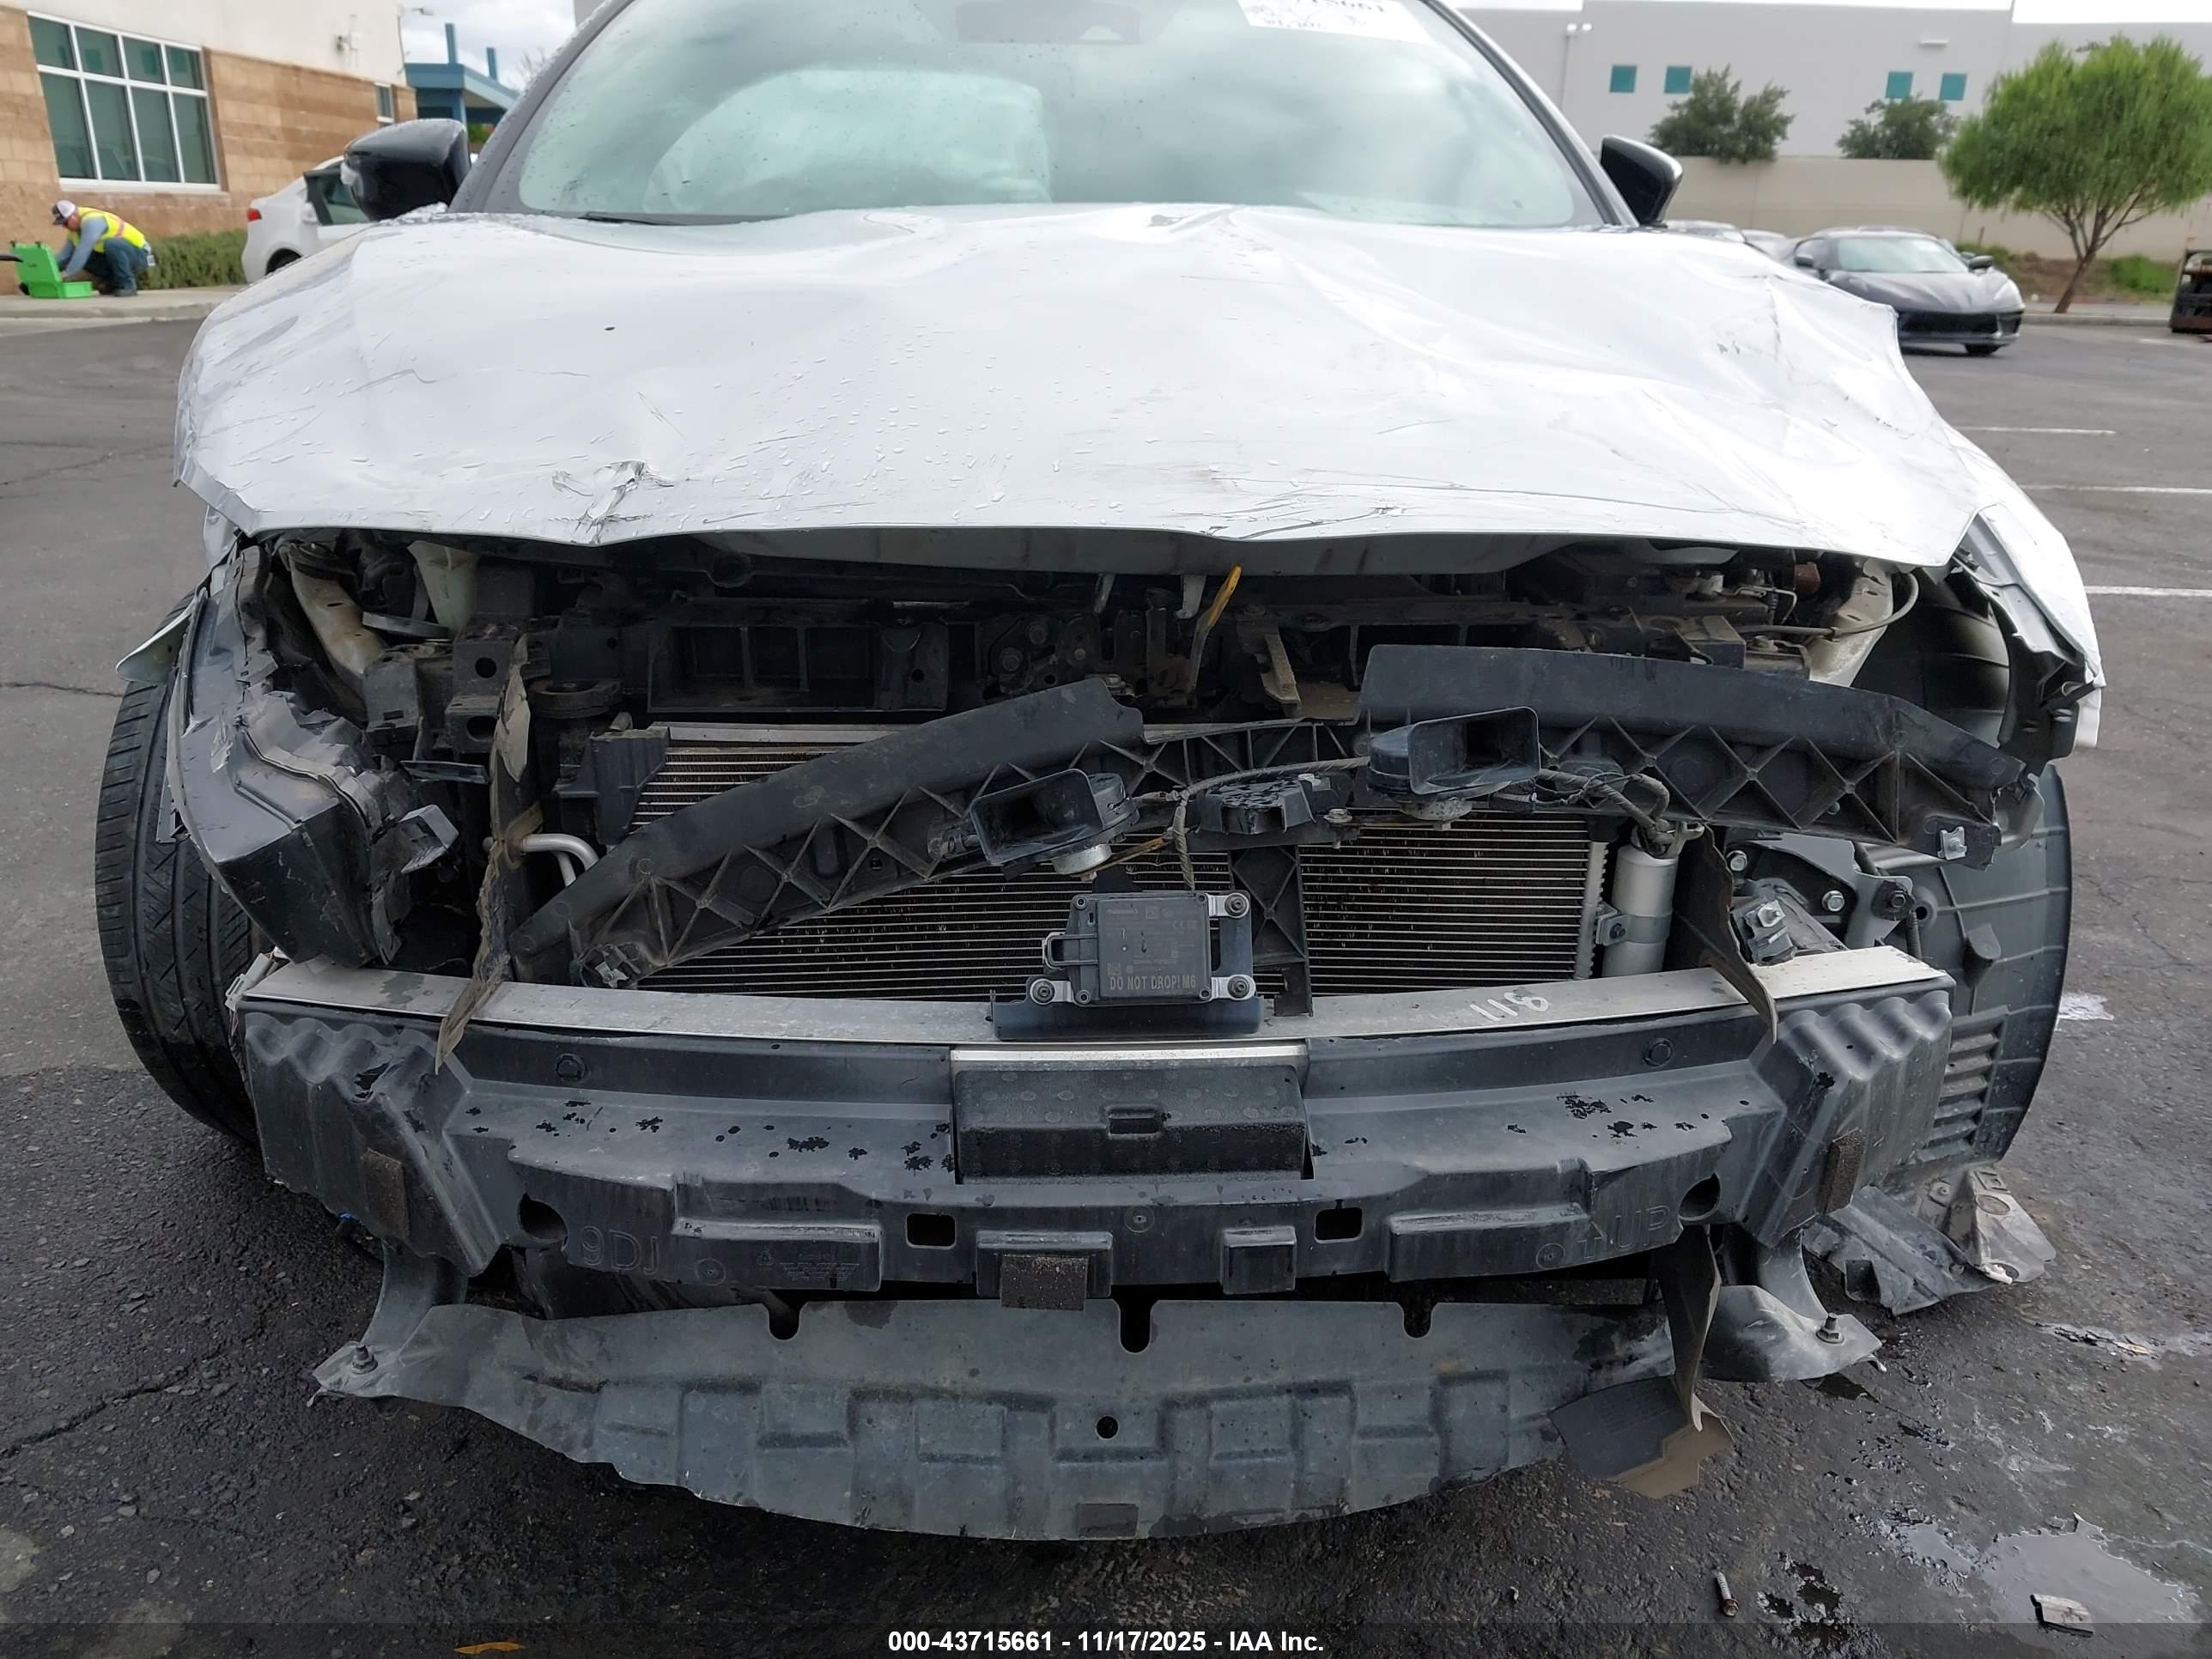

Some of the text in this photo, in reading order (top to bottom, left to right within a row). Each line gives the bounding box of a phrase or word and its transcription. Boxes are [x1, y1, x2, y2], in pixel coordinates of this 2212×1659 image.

[1109, 976, 1124, 990] DO
[1127, 975, 1147, 990] NOT
[1613, 1204, 1670, 1252] UP
